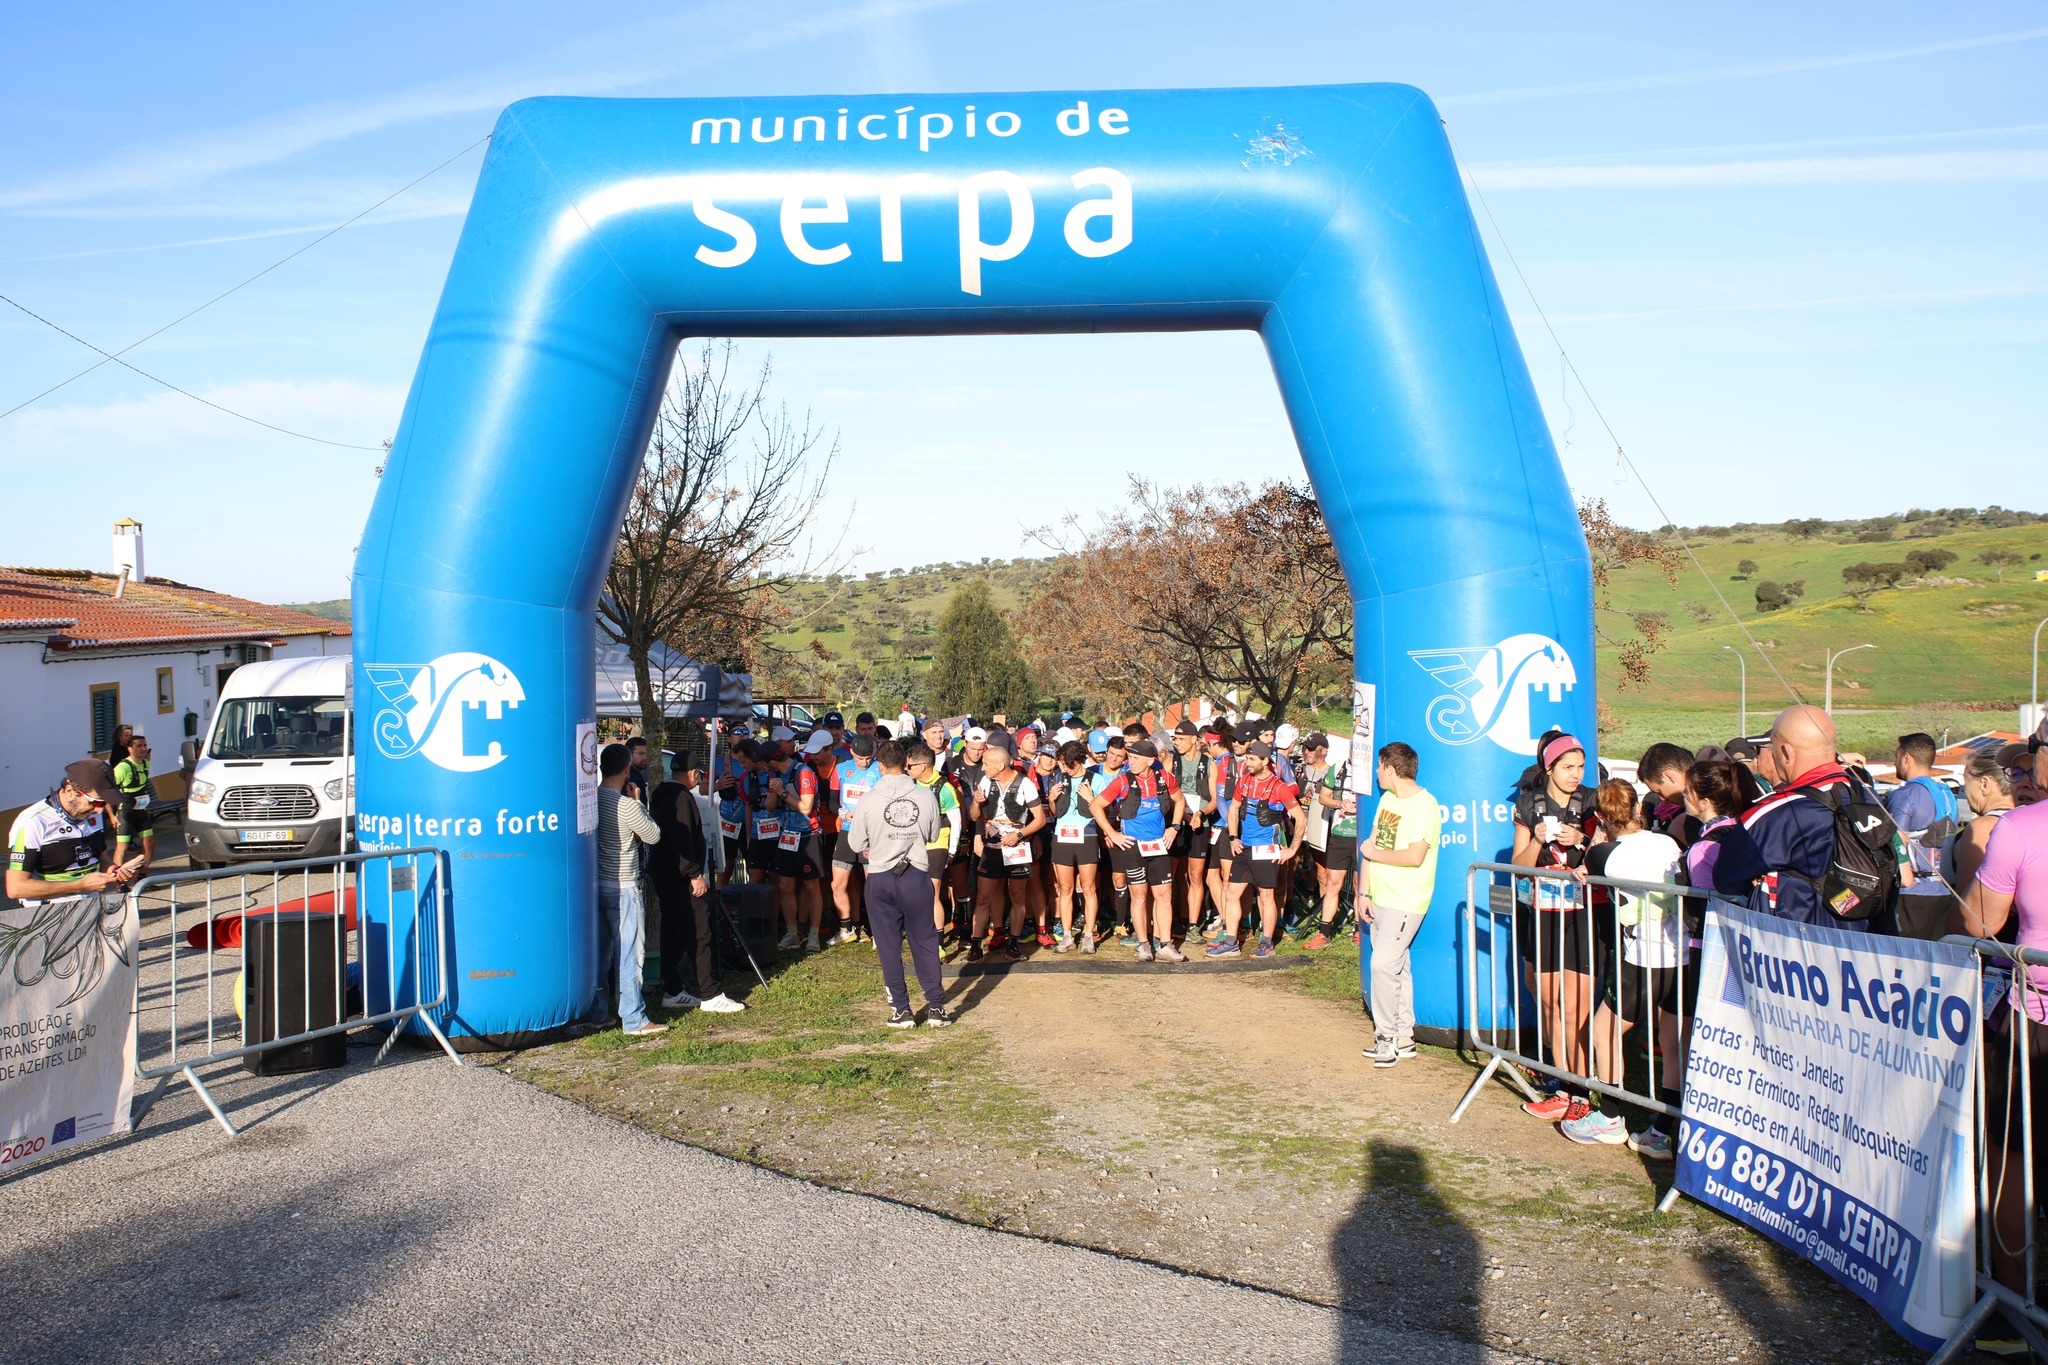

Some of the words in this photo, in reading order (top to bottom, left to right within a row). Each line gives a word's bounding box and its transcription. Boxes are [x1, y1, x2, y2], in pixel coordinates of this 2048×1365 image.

[690, 104, 1022, 152] município
[1055, 101, 1131, 137] de
[692, 166, 1134, 297] serpa
[358, 812, 403, 841] serpa
[414, 813, 482, 837] terra
[496, 808, 559, 835] forte
[66, 1012, 73, 1026] E
[1738, 933, 1830, 1007] Bruno
[1841, 960, 1971, 1047] Acácio
[0, 1065, 15, 1081] DE
[18, 1051, 65, 1077] AZEITES,
[68, 1045, 87, 1062] LDA
[1691, 1017, 1743, 1051] Portas
[1752, 1035, 1794, 1072] Portões
[1802, 1055, 1845, 1095] Janelas
[1749, 995, 1844, 1049] CAIXILHARIA
[1849, 1027, 1870, 1060] DE
[1873, 1037, 1966, 1093] ALUMÍNIO
[1, 1136, 46, 1164] 2020
[1684, 1081, 1767, 1134] Reparações
[1769, 1120, 1788, 1144] em
[1790, 1125, 1842, 1174] Alumínio
[1687, 1049, 1743, 1087] Estores
[1748, 1068, 1801, 1112] Térmicos
[1807, 1095, 1840, 1133] Redes
[1842, 1111, 1929, 1176] Mosquiteiras
[1677, 1119, 1727, 1171] 966
[1731, 1145, 1786, 1200] 882
[1787, 1170, 1832, 1229] 071
[1838, 1200, 1912, 1288] SERPA
[1704, 1175, 1878, 1294] brunoaluminio@gmail.com
